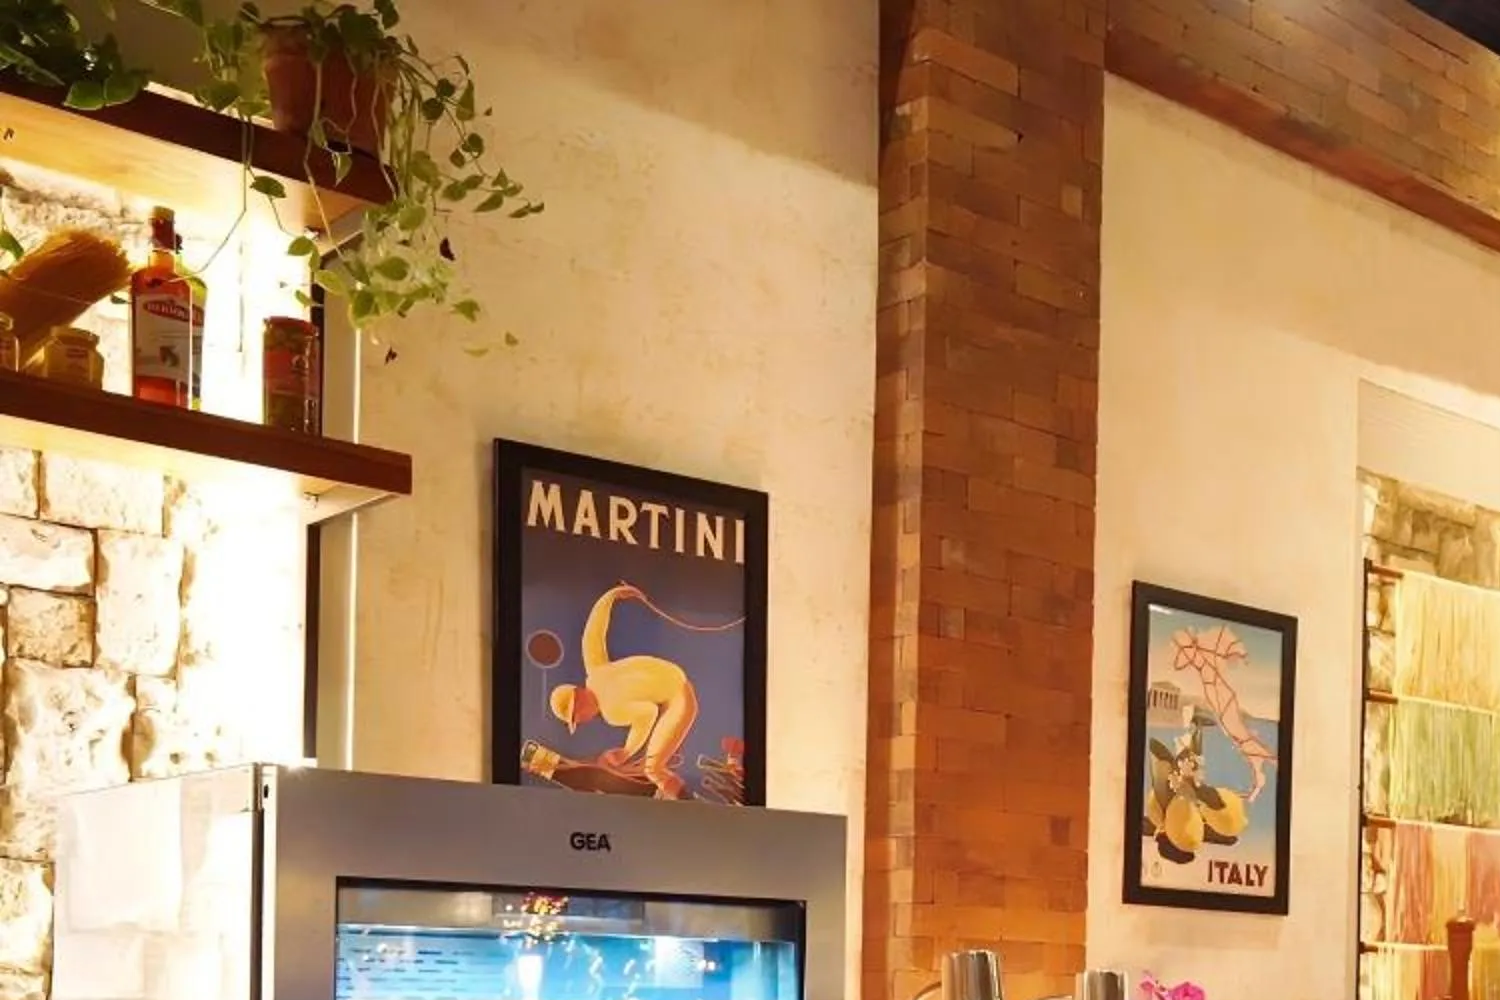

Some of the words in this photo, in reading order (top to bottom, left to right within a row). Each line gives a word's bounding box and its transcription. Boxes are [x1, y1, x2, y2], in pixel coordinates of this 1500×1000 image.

[526, 479, 745, 565] MARTINI
[570, 831, 612, 852] GEA
[1207, 859, 1269, 887] ITALY
